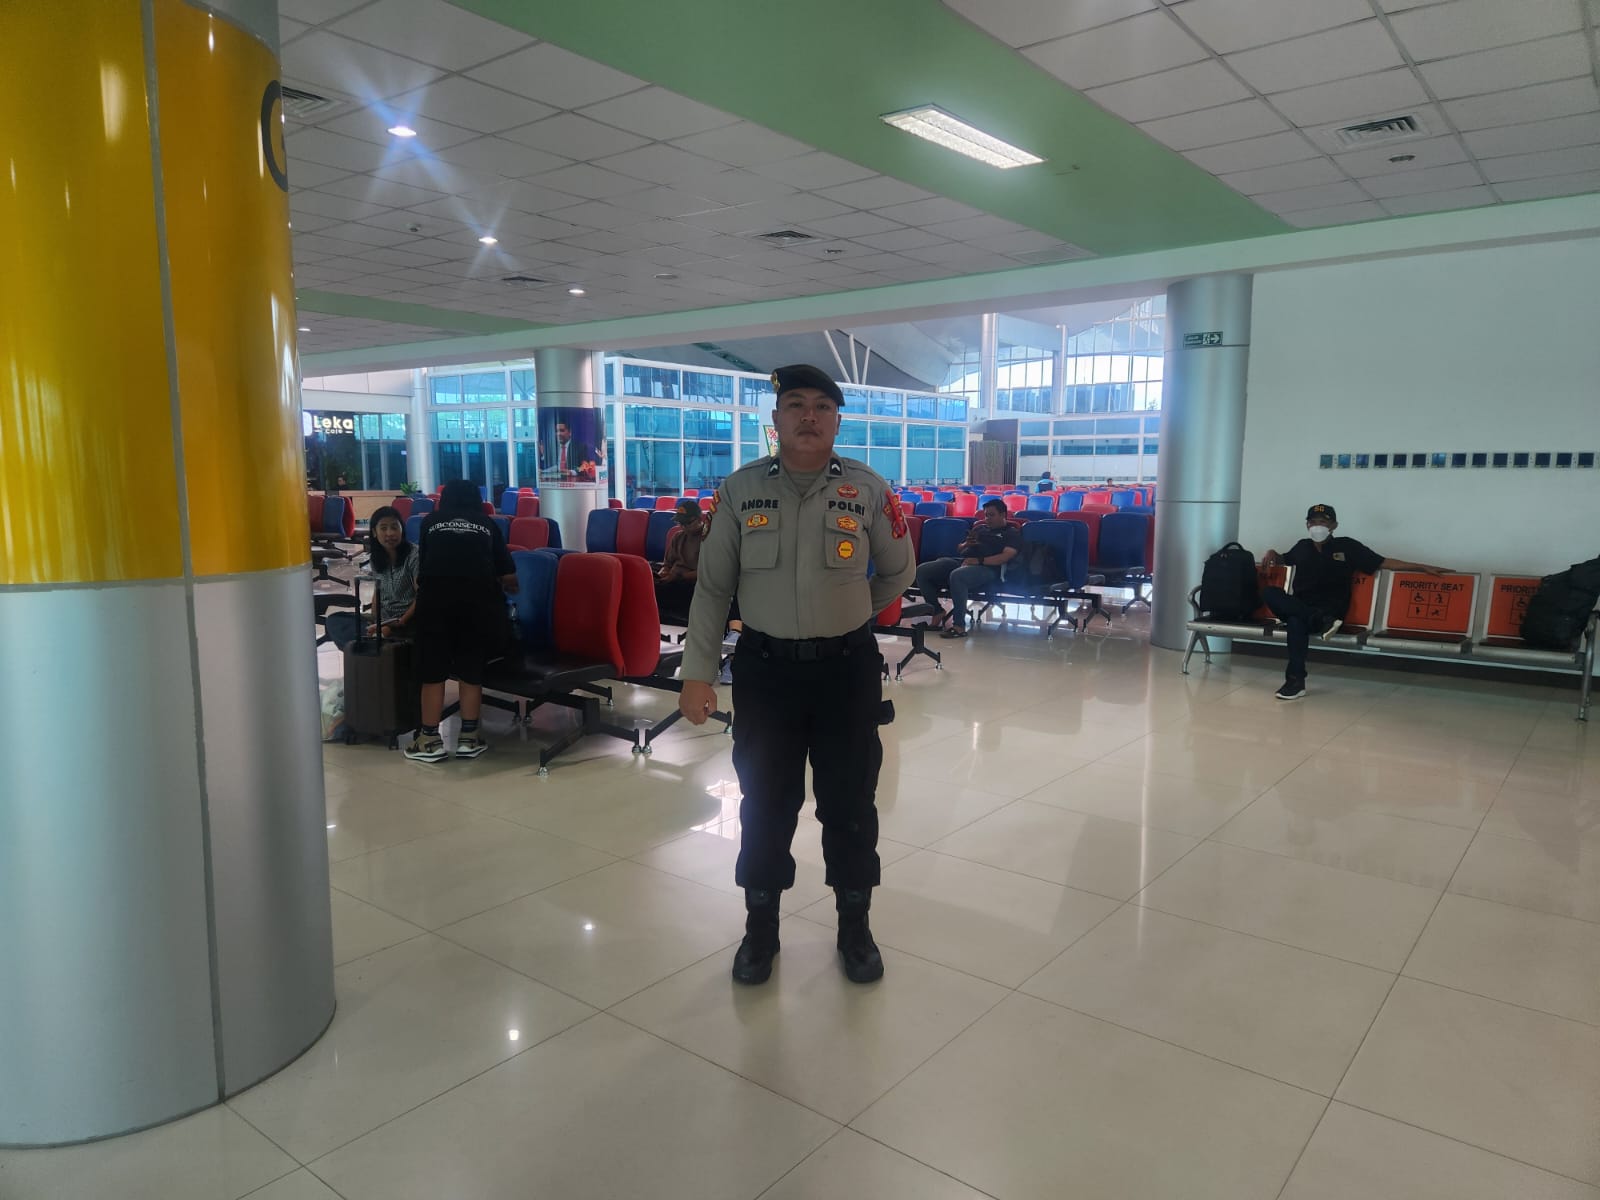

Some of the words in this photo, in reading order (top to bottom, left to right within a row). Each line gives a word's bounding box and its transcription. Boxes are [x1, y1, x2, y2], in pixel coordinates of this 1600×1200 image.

[313, 415, 353, 430] Leka
[741, 499, 779, 512] ANDRE
[828, 500, 865, 516] POLRI
[1399, 580, 1438, 590] PRIORITY
[1441, 583, 1465, 591] SEAT
[1501, 584, 1537, 594] PRIORIT
